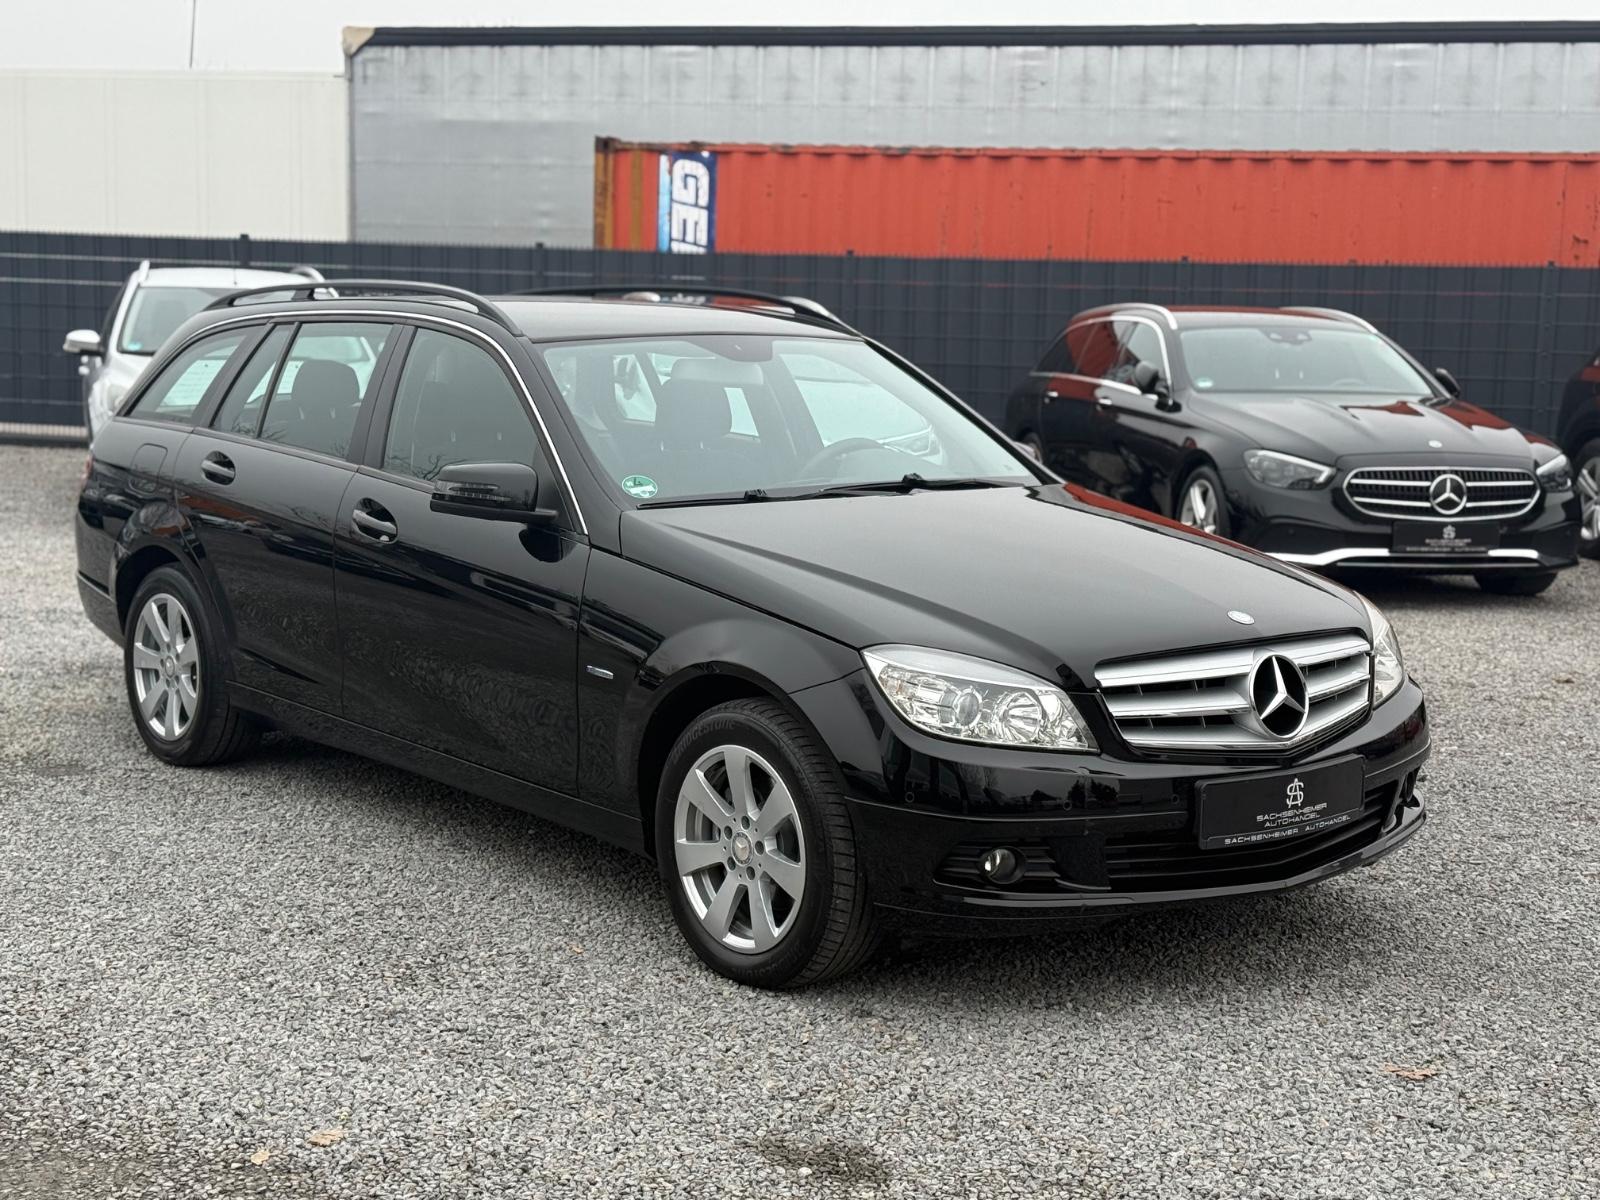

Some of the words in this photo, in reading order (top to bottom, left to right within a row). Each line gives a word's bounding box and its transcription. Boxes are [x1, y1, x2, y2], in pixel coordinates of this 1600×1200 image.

[1256, 802, 1327, 822] SACHSENHEIMER
[1264, 812, 1320, 828] AUTOHANDEL
[1224, 828, 1299, 845] SACHSENHEIMER
[1305, 815, 1351, 831] AUTOHANDEL
